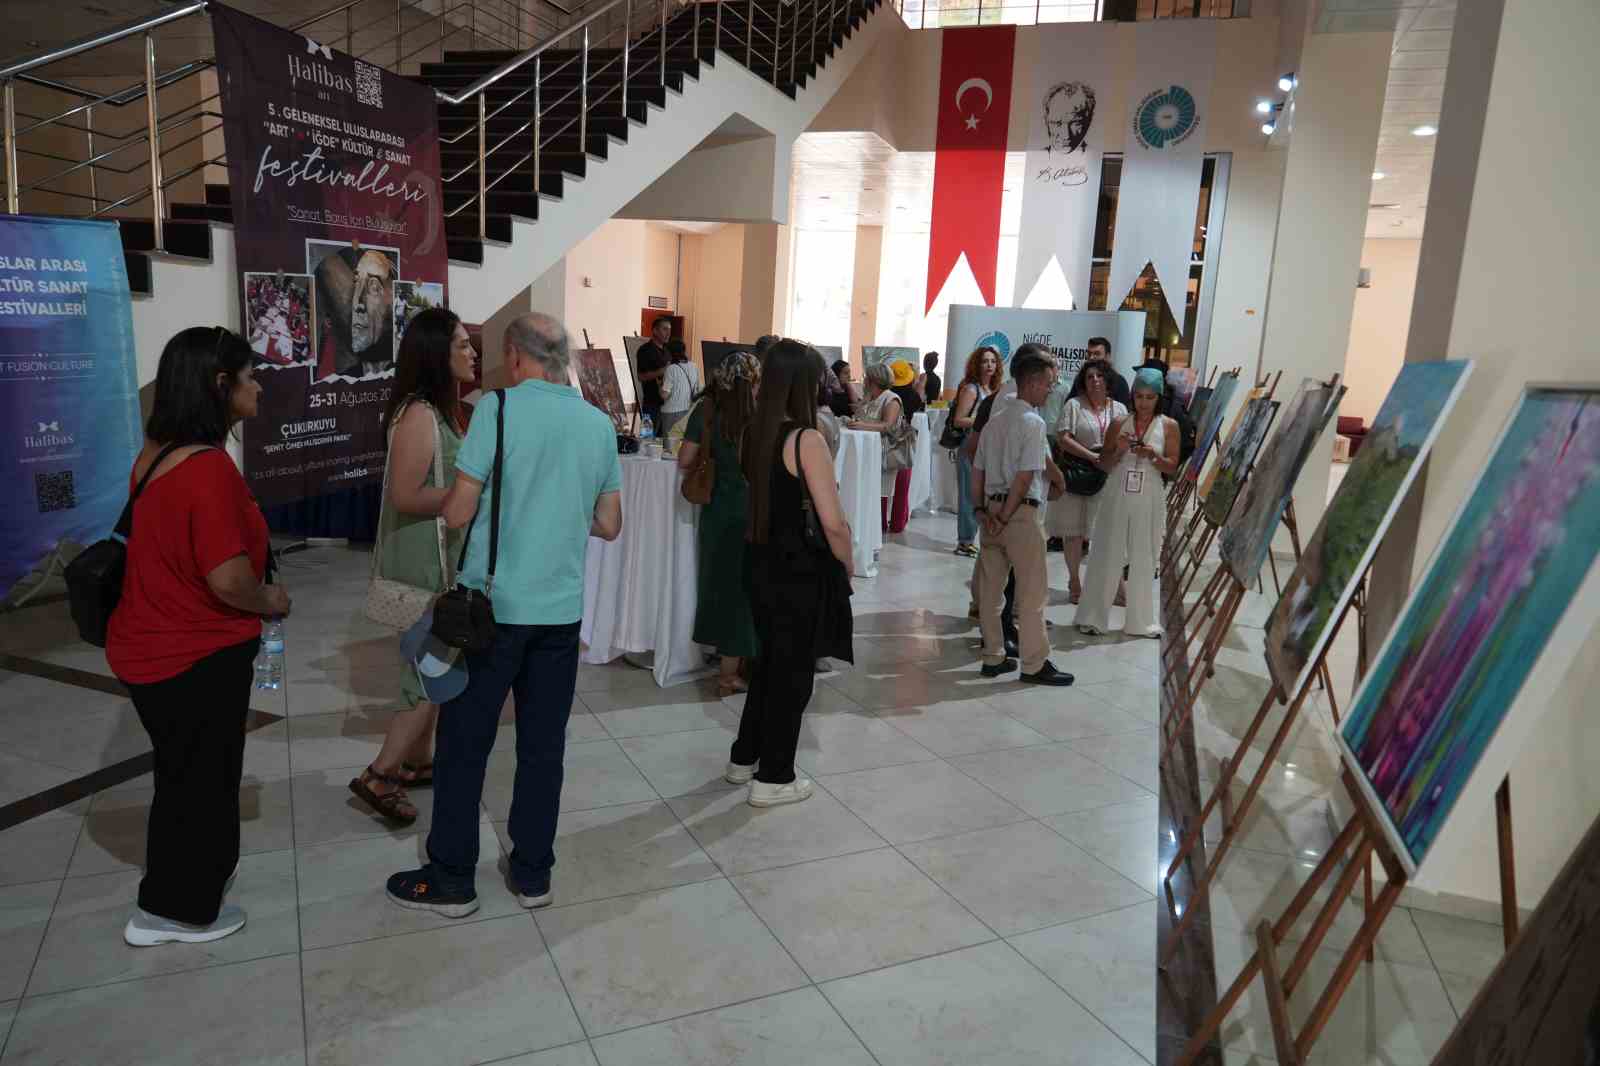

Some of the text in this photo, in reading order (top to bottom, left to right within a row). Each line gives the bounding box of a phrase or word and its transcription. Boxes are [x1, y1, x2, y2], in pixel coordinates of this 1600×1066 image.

[287, 54, 353, 93] Halibas
[282, 106, 342, 132] GELENEKSEL
[343, 121, 406, 148] ULUSLARARASI
[341, 137, 374, 159] KÜLTÜR
[384, 150, 412, 167] SANAT
[254, 145, 428, 201] festivalleri
[41, 258, 88, 273] ARASI
[38, 280, 88, 294] SANAT
[8, 361, 48, 372] FUSION
[49, 359, 94, 370] CULTURE
[309, 387, 391, 408] 25-31 Ağustos 20
[280, 418, 336, 439] ÇUKURKUYU
[24, 433, 75, 449] Halibas
